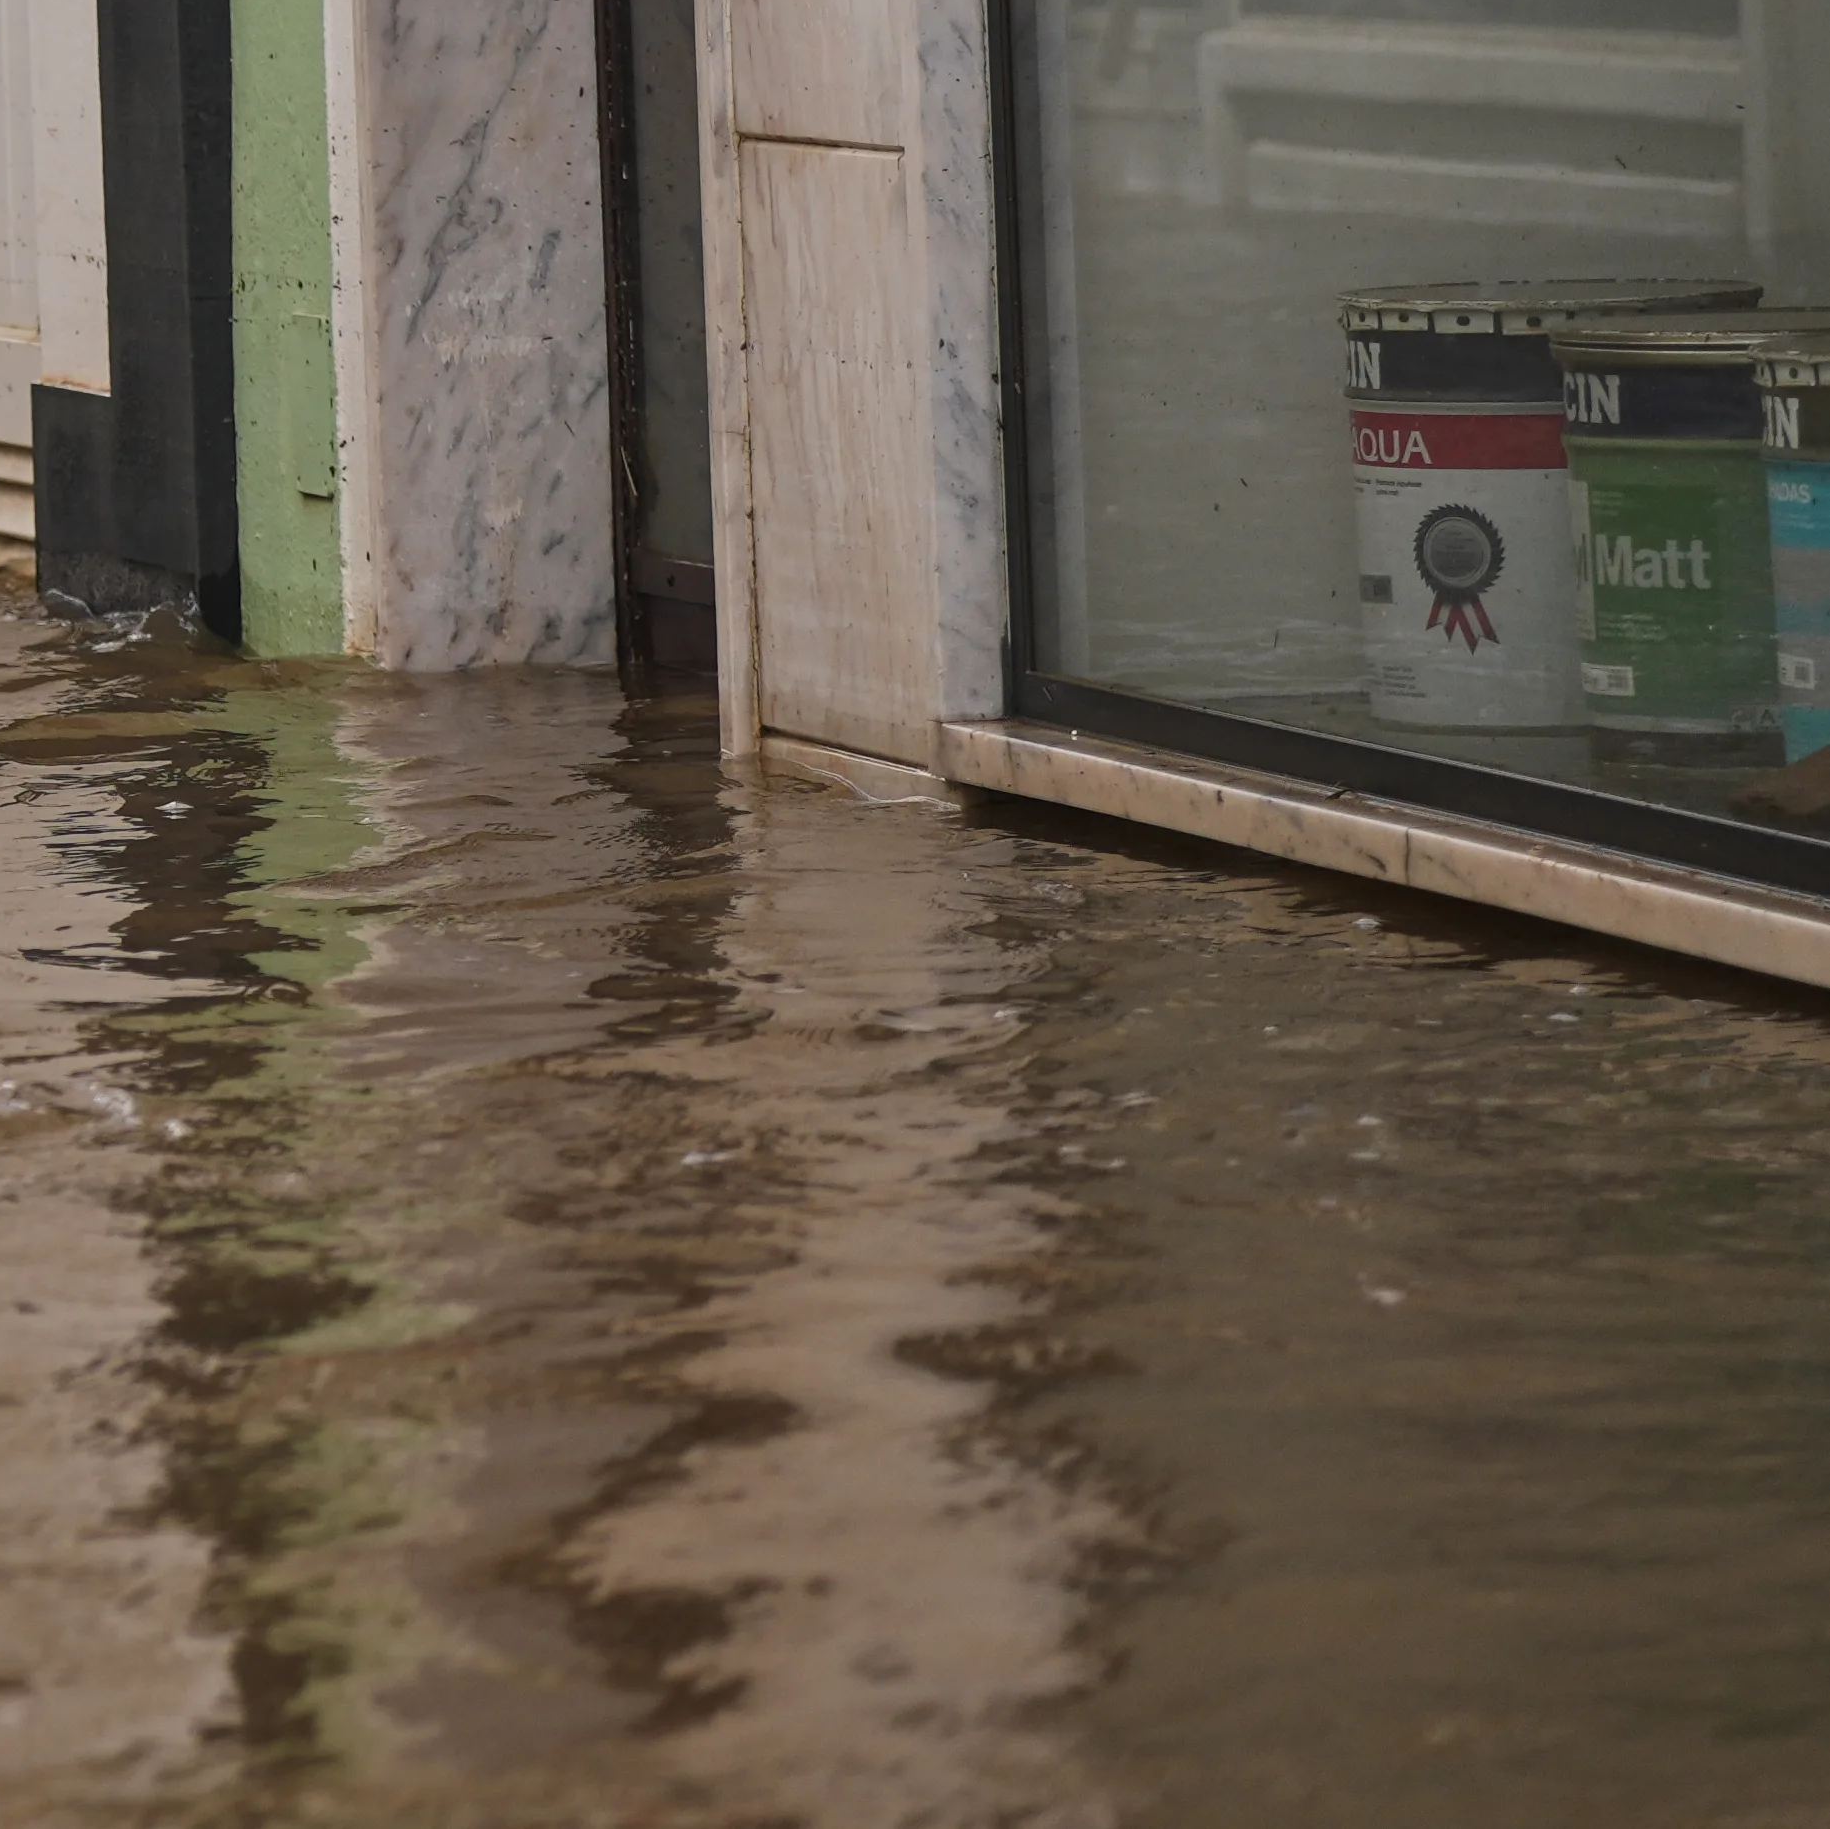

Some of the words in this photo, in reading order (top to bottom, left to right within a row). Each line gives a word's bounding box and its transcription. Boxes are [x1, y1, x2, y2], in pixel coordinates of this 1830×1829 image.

[1347, 340, 1381, 390] IN
[1563, 371, 1621, 424] CIN
[1762, 394, 1800, 449] IN
[1594, 533, 1712, 590] Matt
